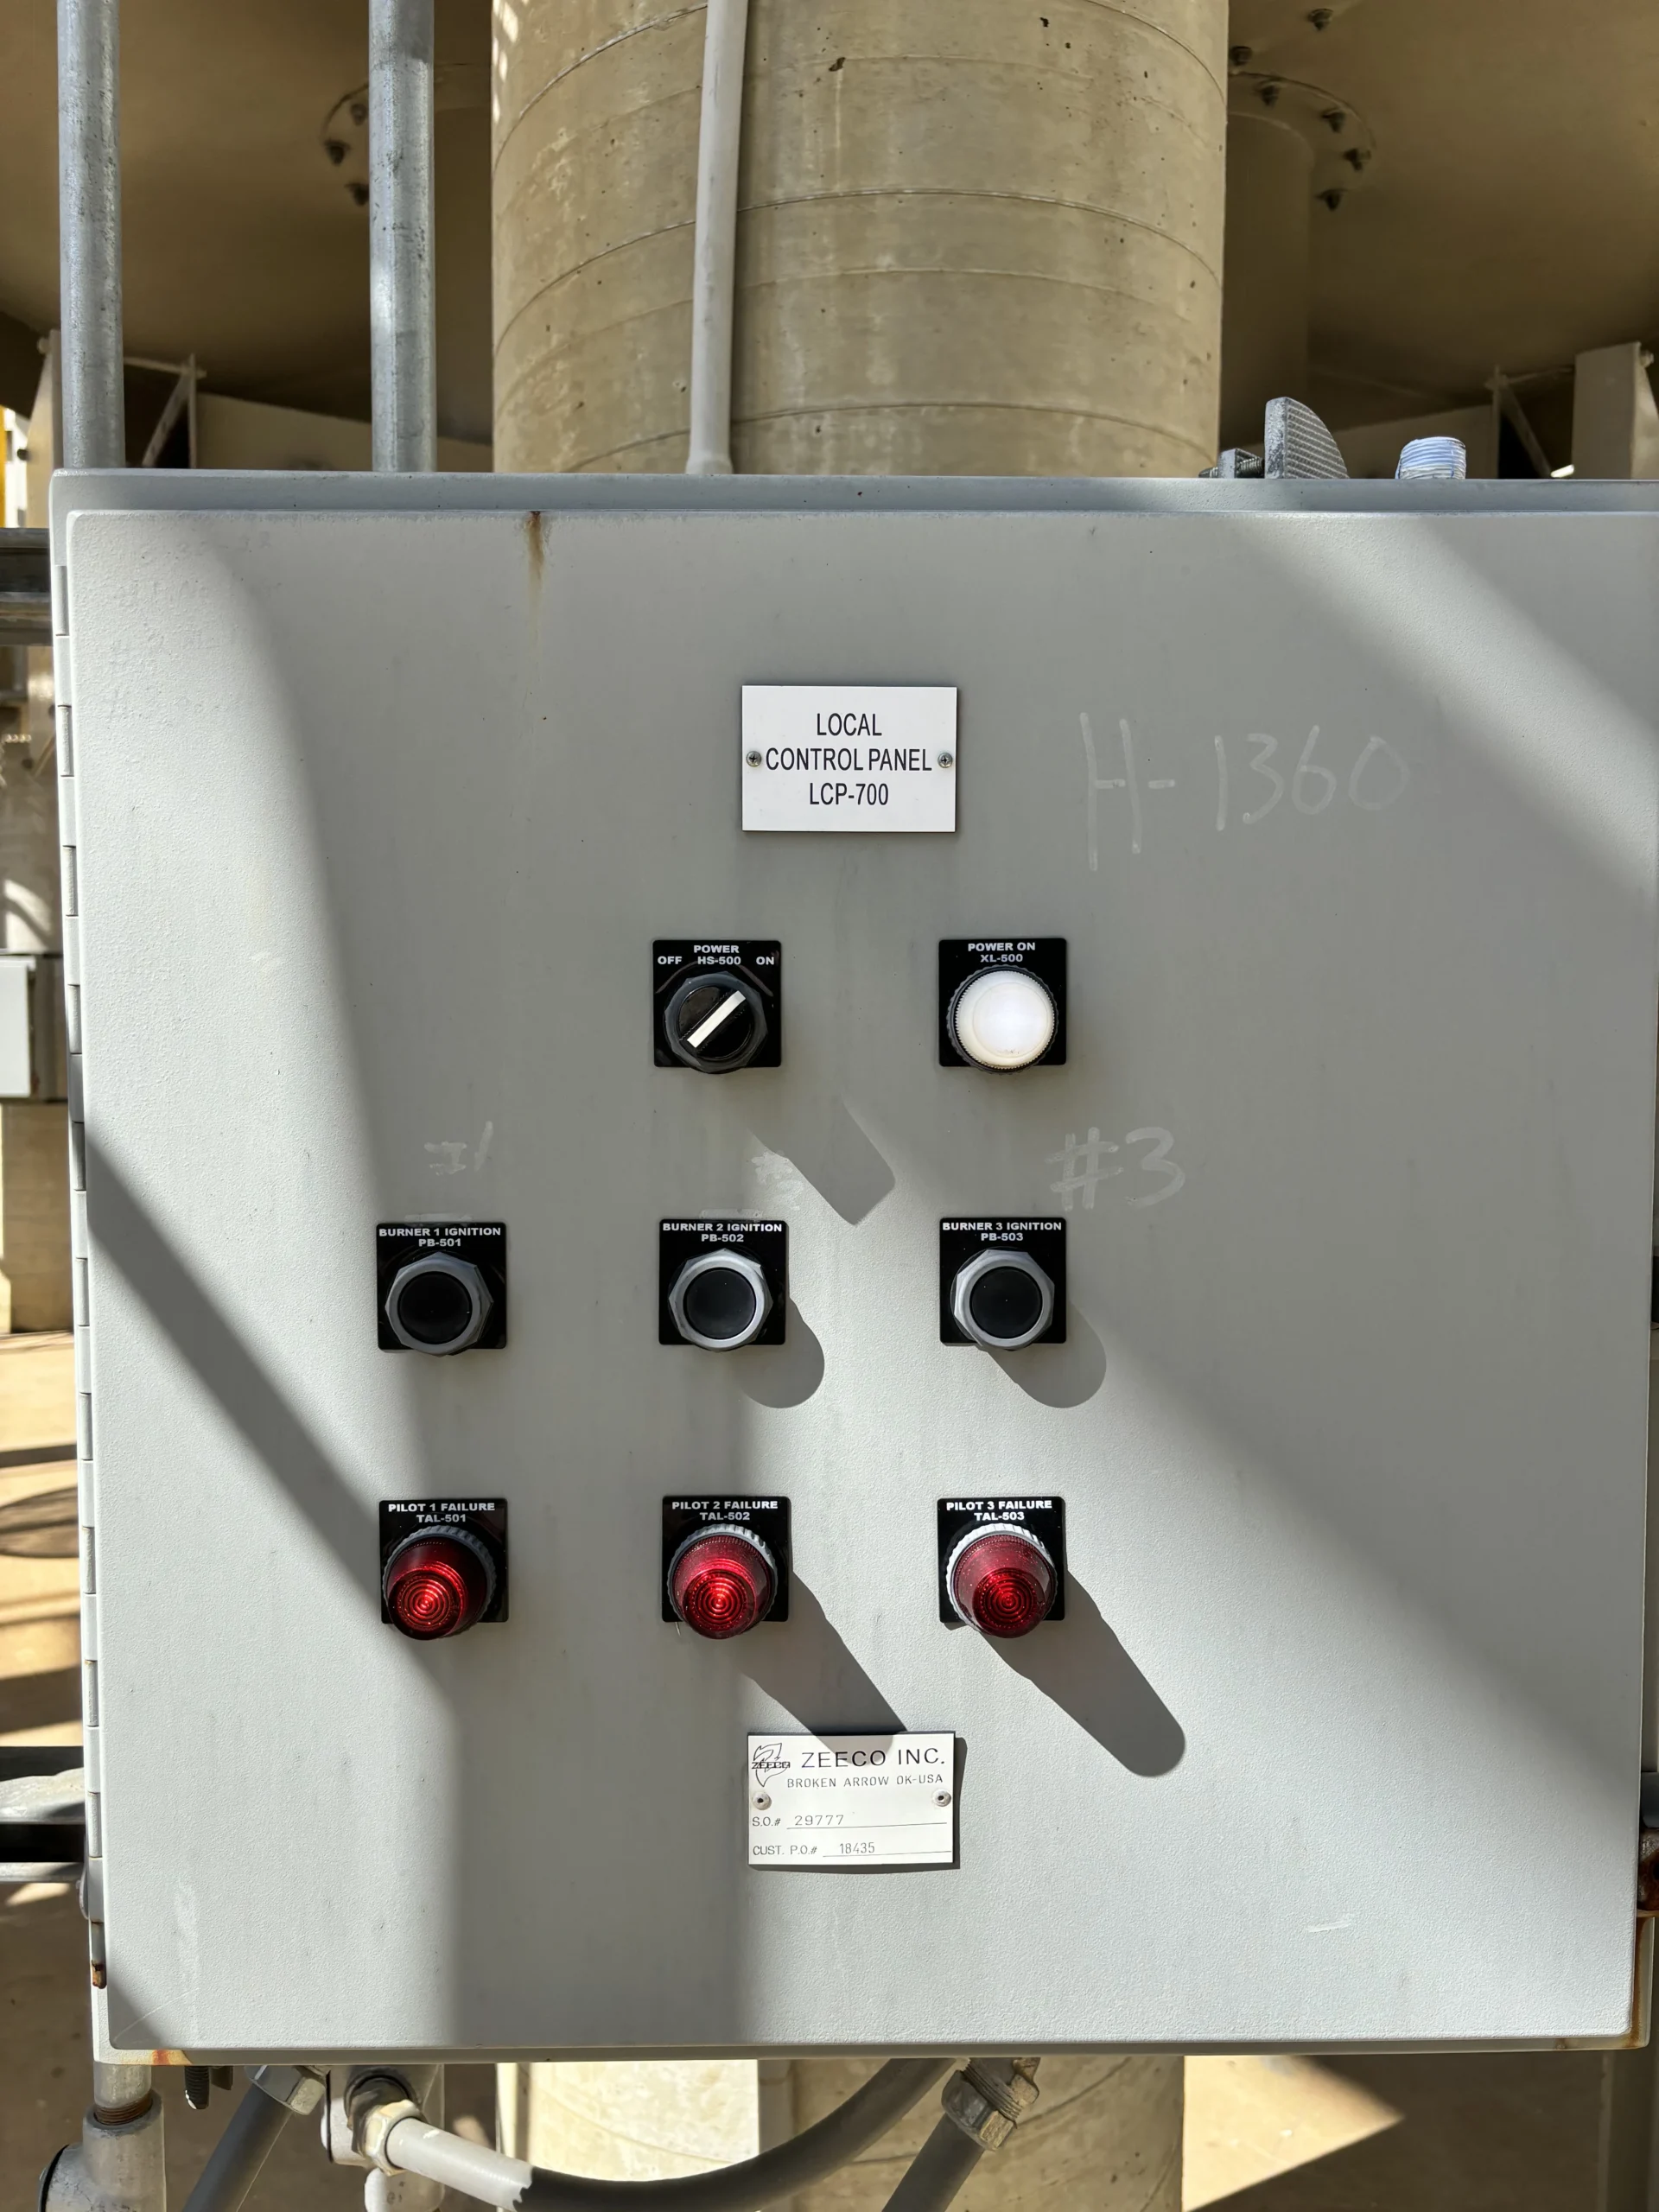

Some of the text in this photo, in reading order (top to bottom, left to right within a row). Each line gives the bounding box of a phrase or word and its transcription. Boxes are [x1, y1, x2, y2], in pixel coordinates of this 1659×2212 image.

[817, 713, 882, 736] LOCAL
[766, 747, 932, 772] CONTROL PANEL
[809, 782, 889, 805] LCP-700
[693, 944, 740, 954] POWER
[968, 942, 1036, 951] POWER ON
[658, 956, 682, 965] OFF
[697, 956, 741, 965] HS-500
[755, 956, 775, 965] ON
[980, 954, 1023, 963] XL-500
[1045, 1127, 1185, 1211] #3
[663, 1223, 714, 1231] BURNER
[727, 1224, 782, 1232] IGNITION
[942, 1222, 1062, 1230] BURNER 3 IGNITION
[378, 1229, 430, 1237] BURNER
[445, 1227, 501, 1236] IGNITION
[981, 1232, 1023, 1242] PB-503
[418, 1238, 461, 1247] PB-501
[701, 1234, 744, 1243] PB-502
[388, 1503, 426, 1512] PILOT
[441, 1503, 495, 1511] FAILURE
[671, 1500, 779, 1510] PILOT 2 FAILURE
[946, 1500, 1052, 1511] PILOT 3 FAILURE
[416, 1514, 467, 1523] TAL-501
[699, 1512, 750, 1521] TAL-502
[974, 1511, 1025, 1521] TAL-503
[801, 1747, 945, 1769] ZEECO INC.
[787, 1774, 944, 1789] BROKEN ARROW OK-USA
[752, 1815, 845, 1827] S.O.# 29777
[752, 1842, 875, 1856] CUST. P.O.# 18435
